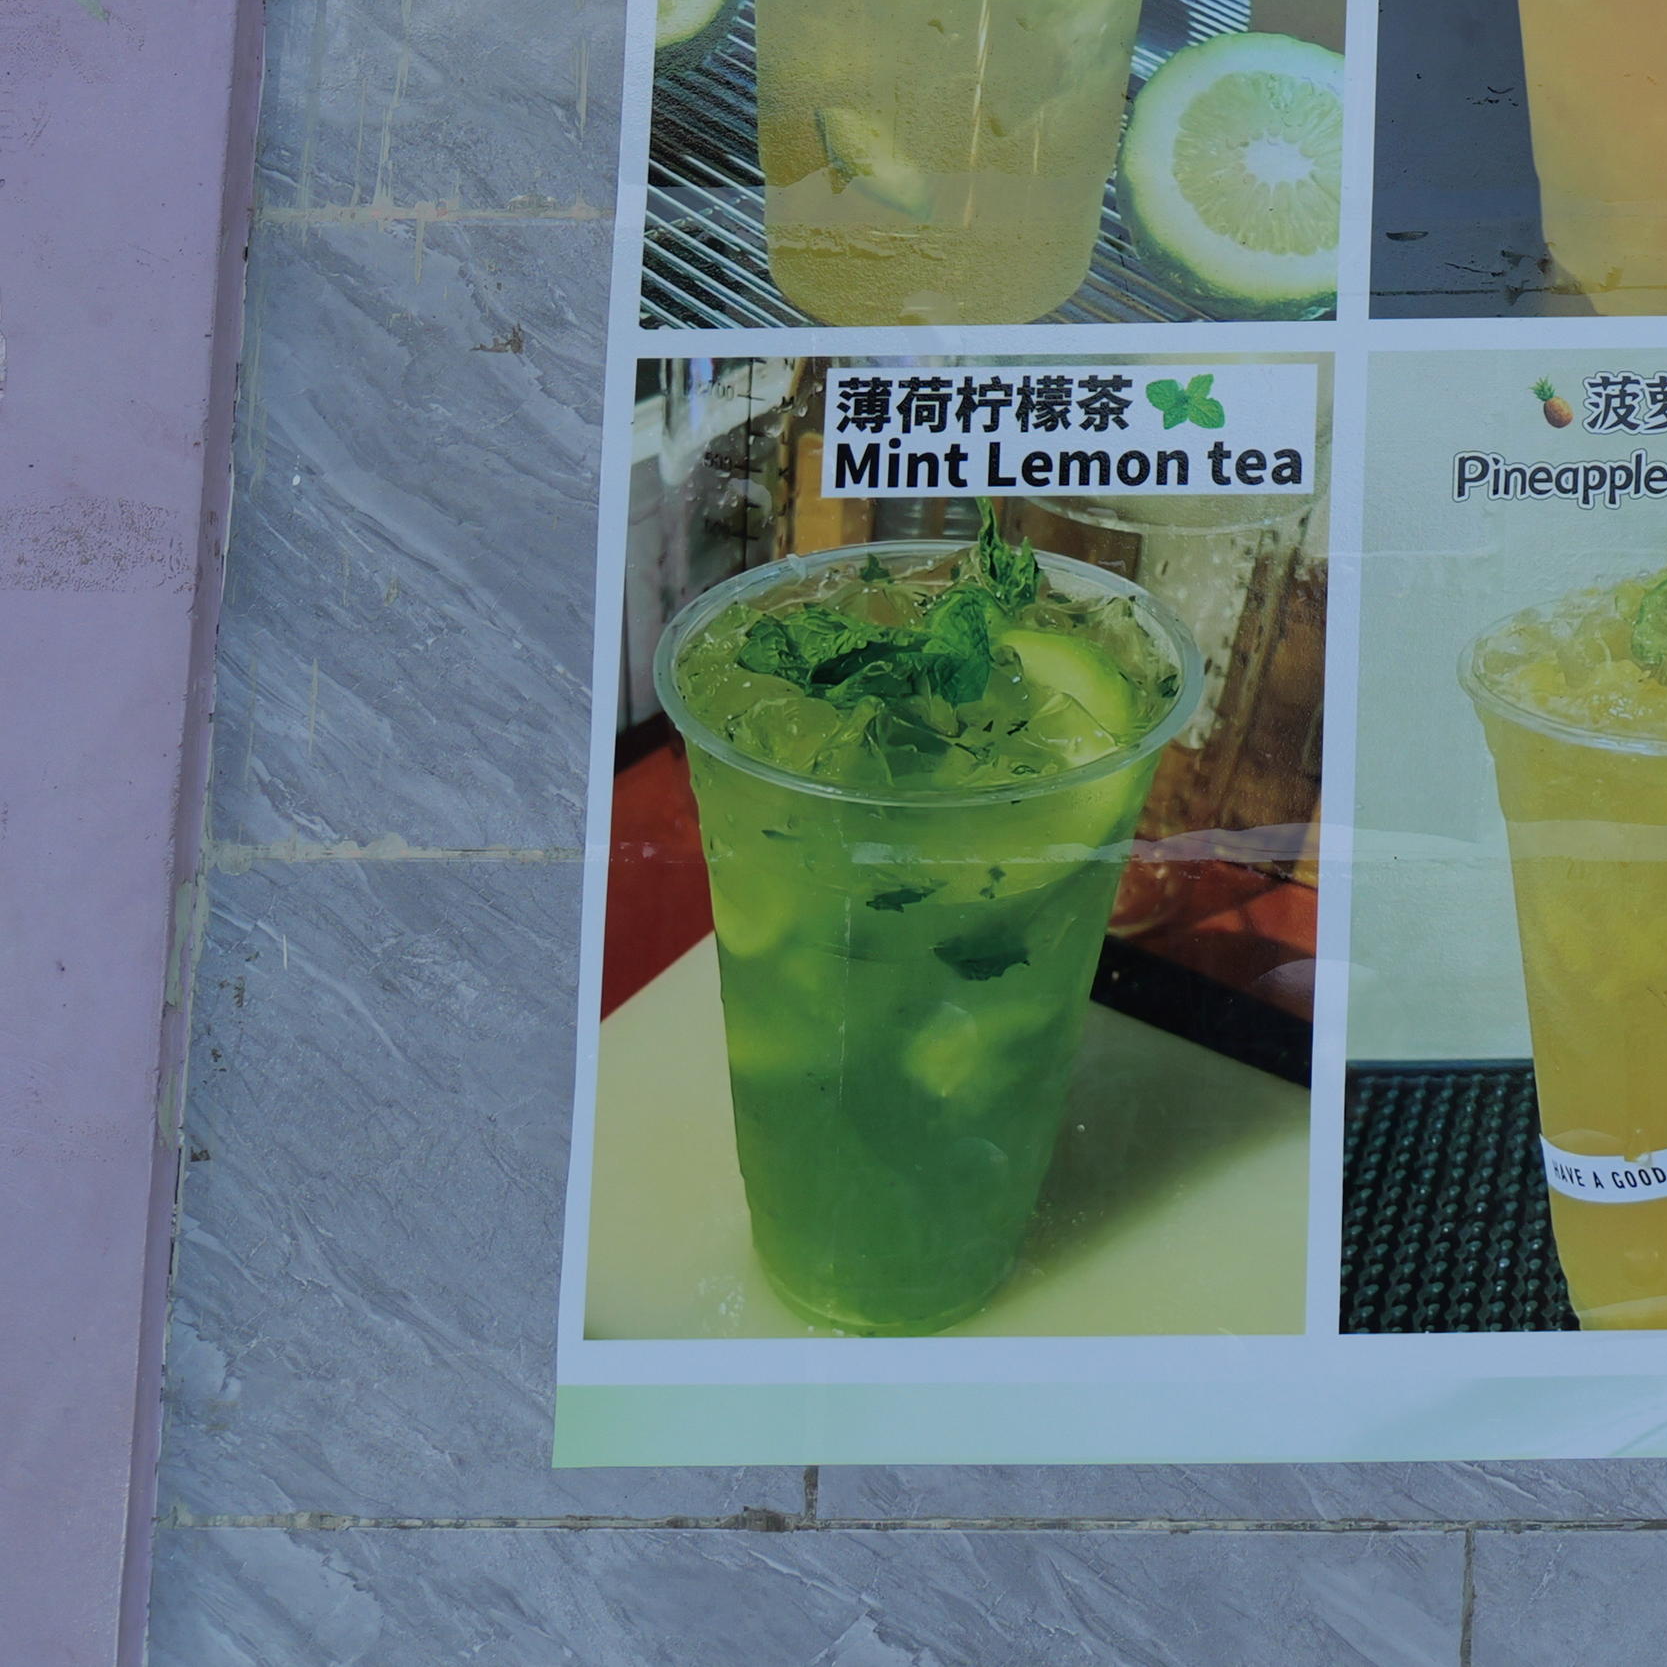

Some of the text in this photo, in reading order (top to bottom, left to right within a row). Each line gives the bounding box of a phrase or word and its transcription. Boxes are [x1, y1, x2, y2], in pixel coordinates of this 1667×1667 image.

[837, 375, 1133, 433] 薄荷柠檬茶
[835, 439, 1303, 488] Mint Lemon tea
[1593, 1172, 1604, 1189] A
[1611, 1167, 1667, 1189] GOOD
